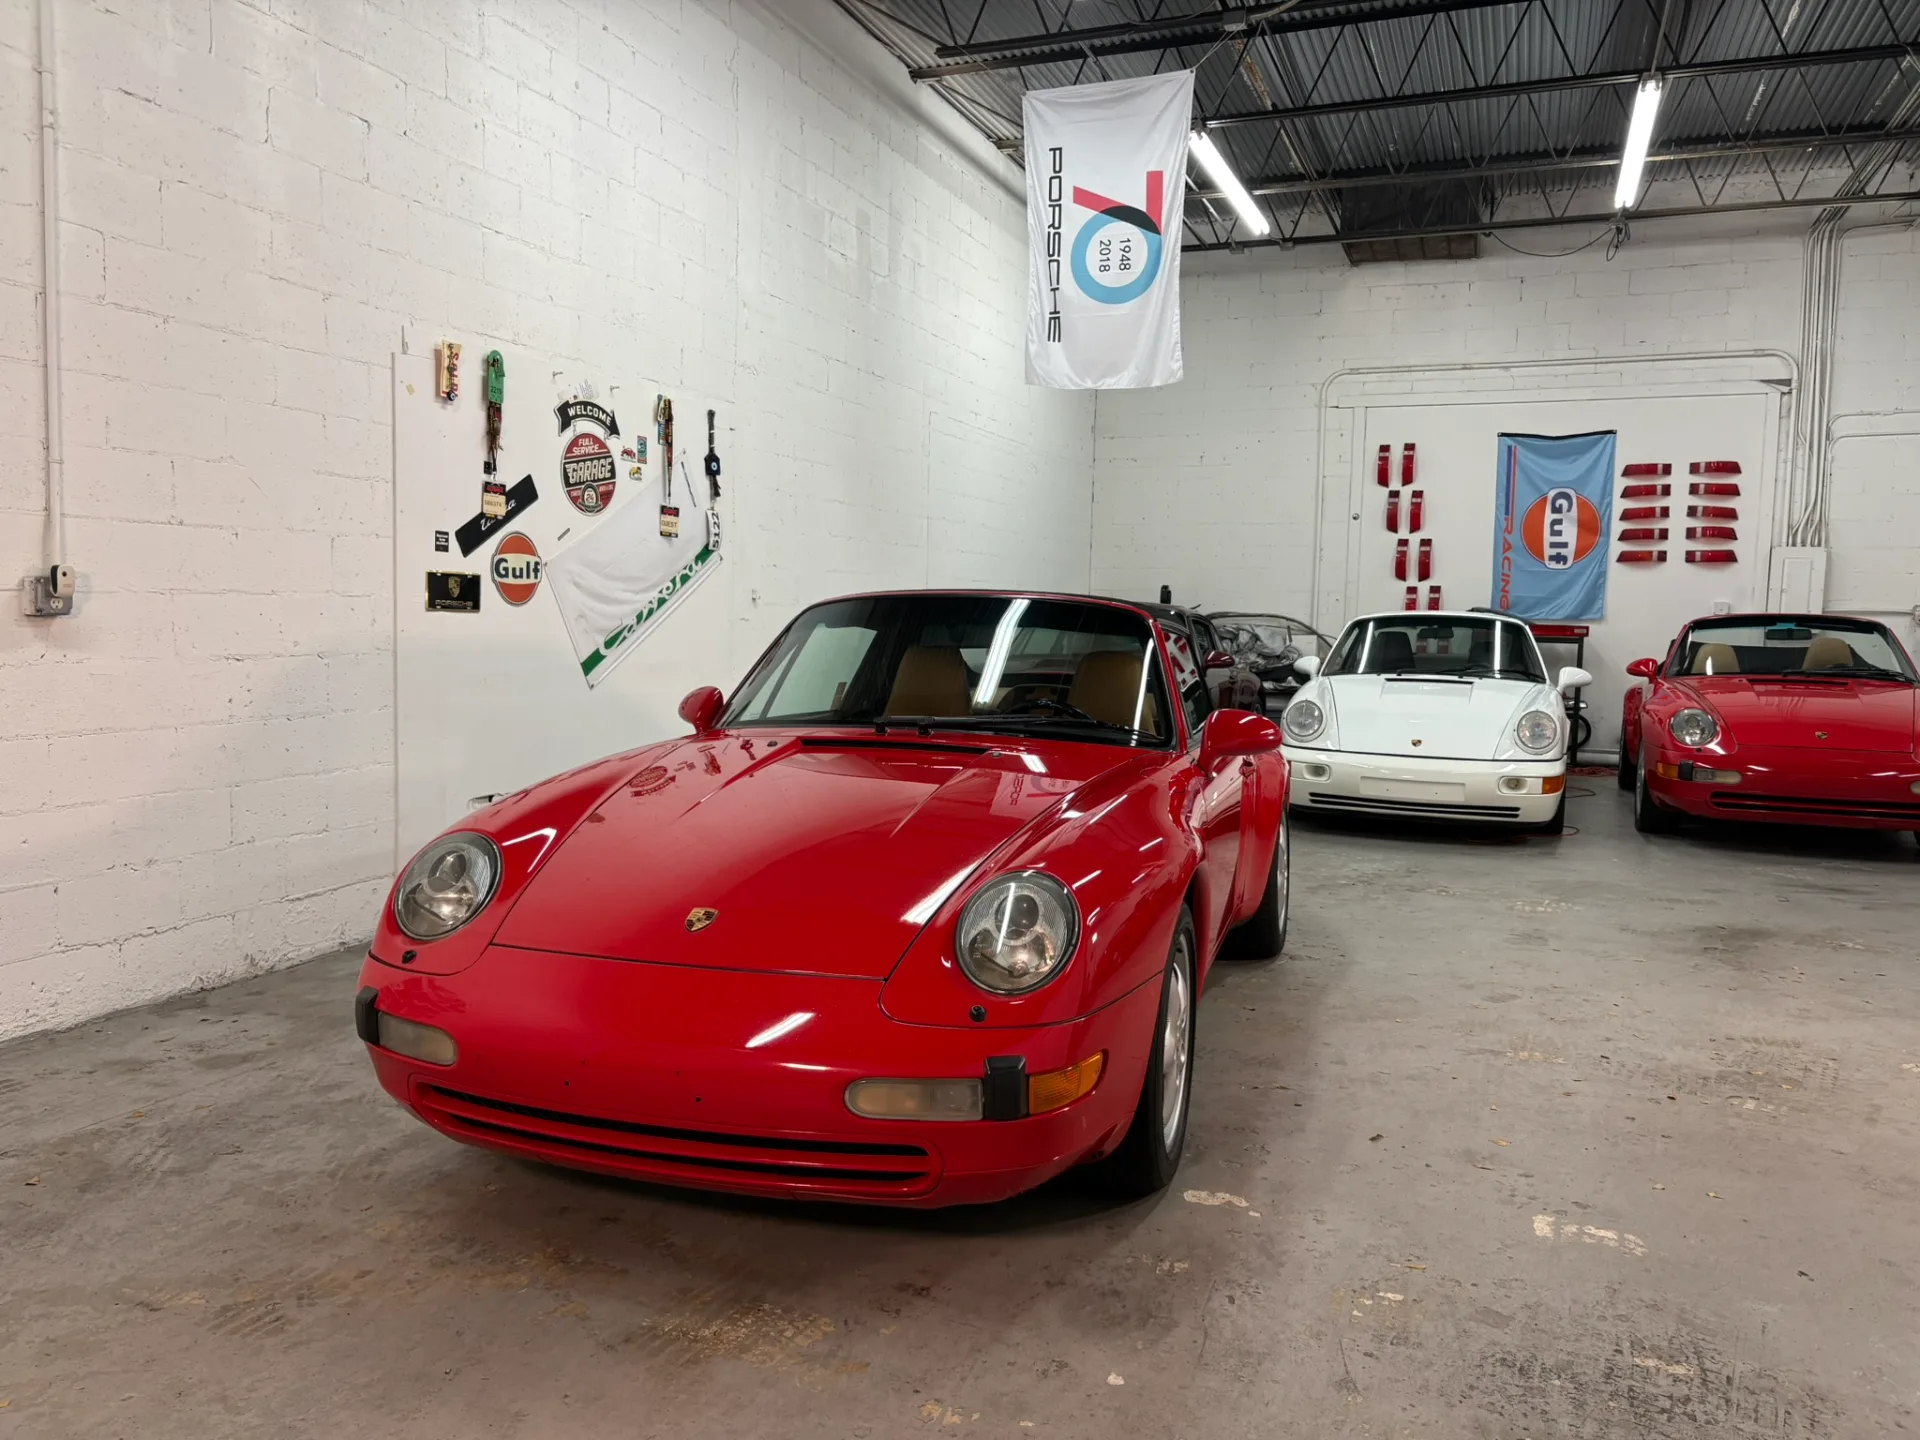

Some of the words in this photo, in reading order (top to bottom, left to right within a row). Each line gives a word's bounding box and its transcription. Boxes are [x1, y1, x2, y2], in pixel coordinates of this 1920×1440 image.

[1046, 147, 1063, 343] PORSCHE
[1098, 238, 1111, 273] 2018
[1119, 237, 1132, 271] 1948
[567, 405, 612, 426] WELCOME
[572, 444, 600, 456] SERVICE
[579, 438, 594, 446] FULL
[566, 457, 613, 484] GARAGE
[661, 520, 678, 529] GUEST
[1548, 491, 1574, 566] Gulf
[494, 557, 541, 580] Gulf
[1499, 516, 1515, 611] RACING
[435, 599, 474, 608] PORSCHE
[598, 557, 704, 656] Carrera
